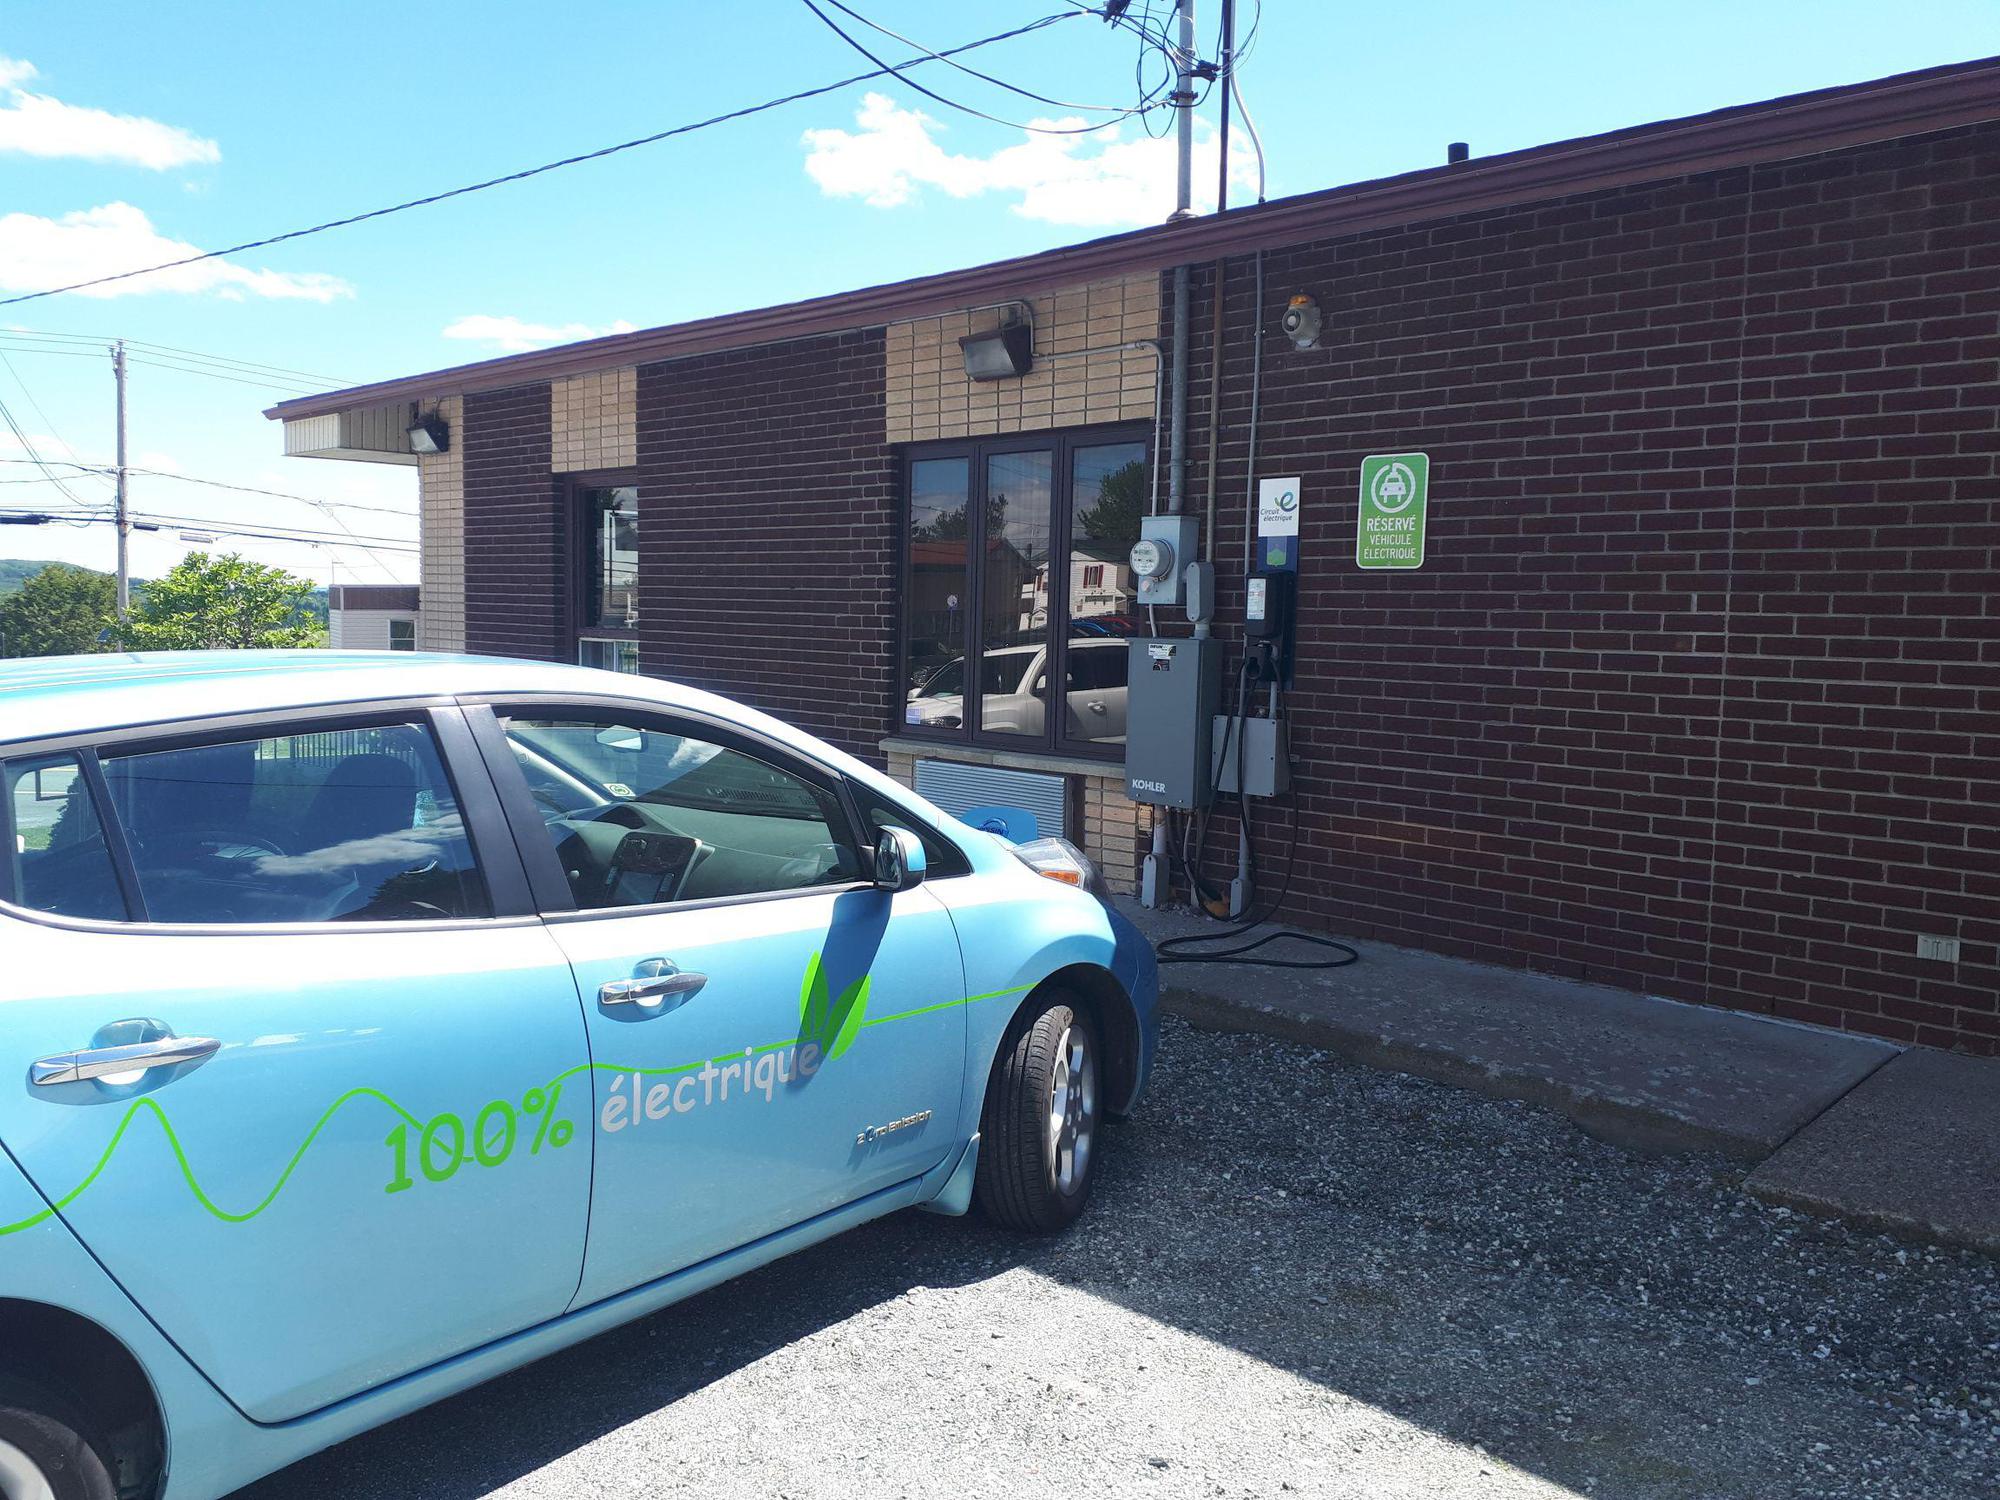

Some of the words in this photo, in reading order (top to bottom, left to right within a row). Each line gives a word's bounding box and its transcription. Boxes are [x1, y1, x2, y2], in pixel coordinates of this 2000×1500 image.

[1260, 508, 1280, 516] Circuit
[1366, 514, 1416, 532] RÉSERVÉ
[1132, 778, 1166, 793] KOHLER
[384, 1083, 575, 1194] 100%
[600, 1043, 820, 1133] électrique
[888, 1109, 932, 1133] Emission
